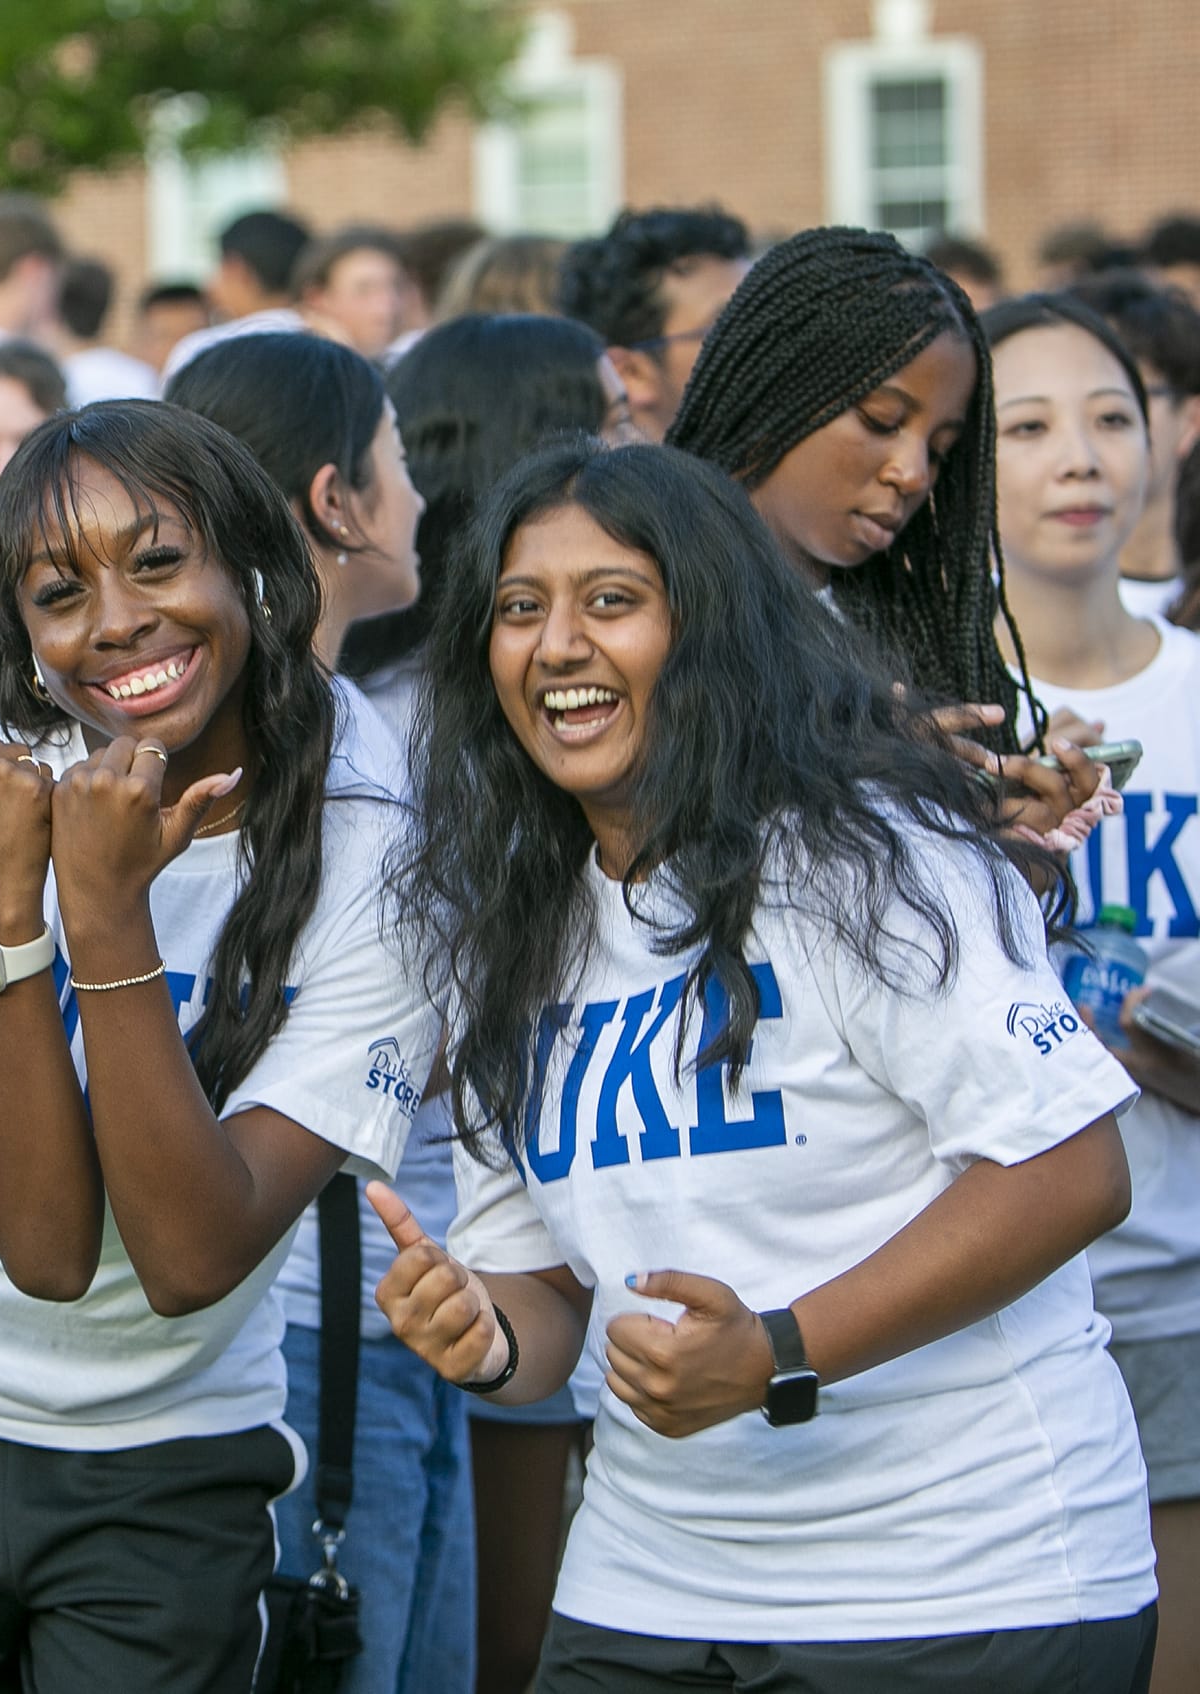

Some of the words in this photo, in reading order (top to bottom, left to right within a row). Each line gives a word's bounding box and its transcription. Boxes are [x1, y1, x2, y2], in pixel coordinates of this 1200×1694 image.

[1018, 1001, 1065, 1037] Duke
[365, 1068, 420, 1114] STORE
[468, 952, 788, 1188] UKE
